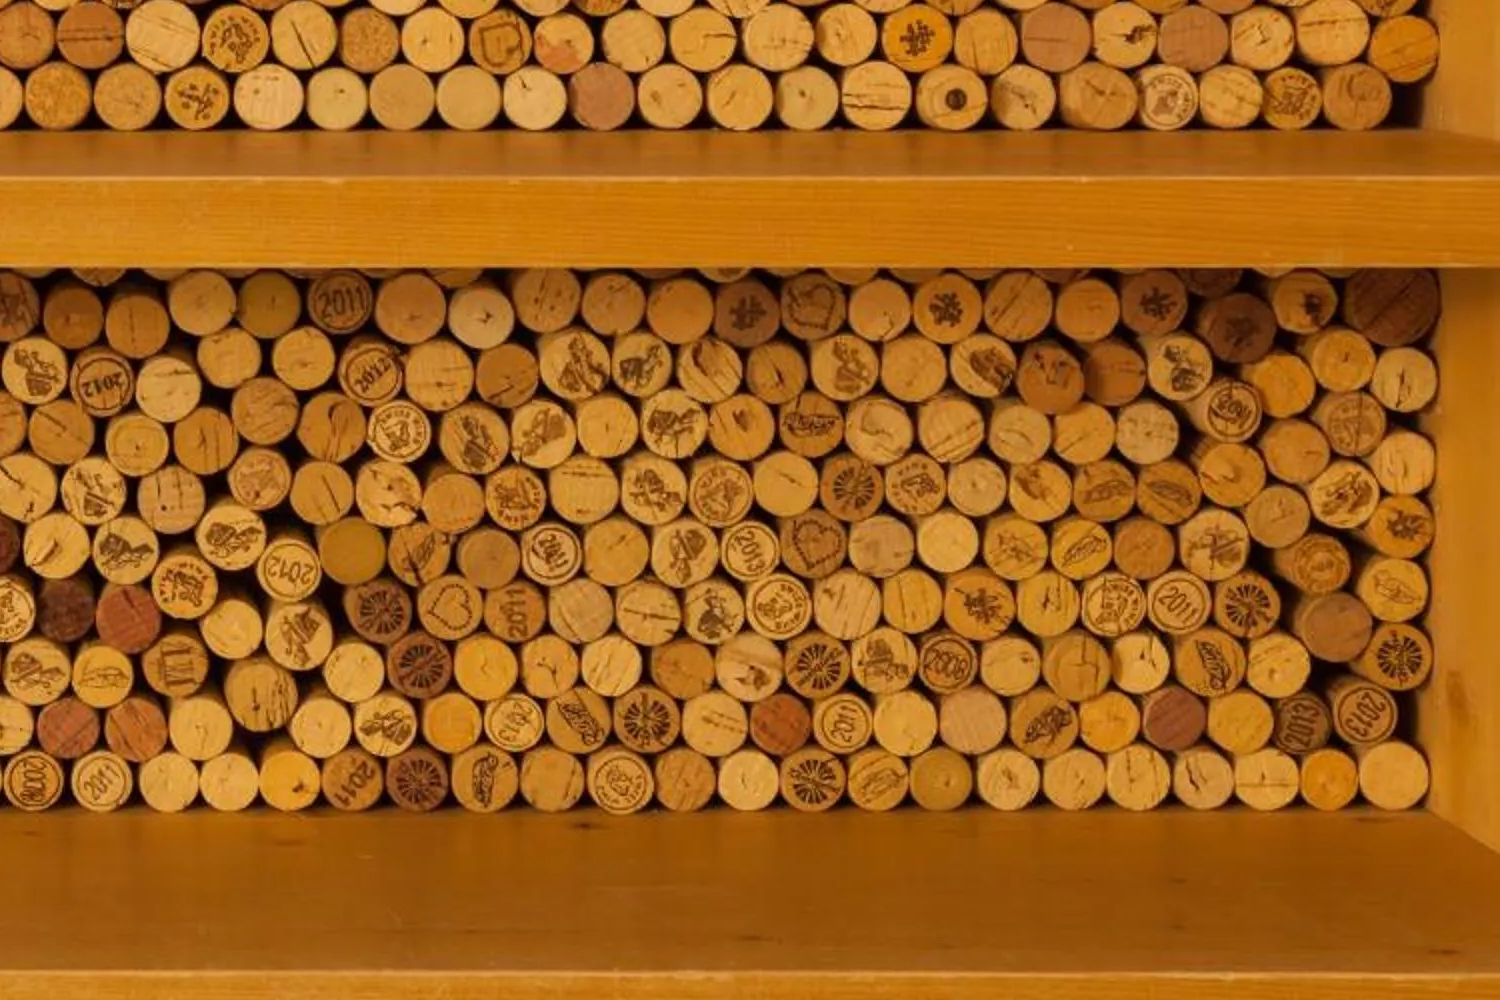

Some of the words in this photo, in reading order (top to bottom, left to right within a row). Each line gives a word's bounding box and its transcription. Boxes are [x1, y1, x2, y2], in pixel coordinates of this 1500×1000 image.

[240, 15, 260, 43] WINE
[319, 288, 365, 319] 2011
[82, 372, 122, 397] 2012
[355, 357, 391, 393] 2012
[734, 530, 765, 571] 2013
[268, 555, 313, 584] 2012
[501, 589, 527, 637] 2011
[1158, 586, 1198, 624] 2011
[831, 706, 857, 742] 2011
[1285, 703, 1320, 747] 2013
[1345, 692, 1385, 736] 2013
[83, 766, 119, 800] 2011
[335, 760, 375, 805] 2011
